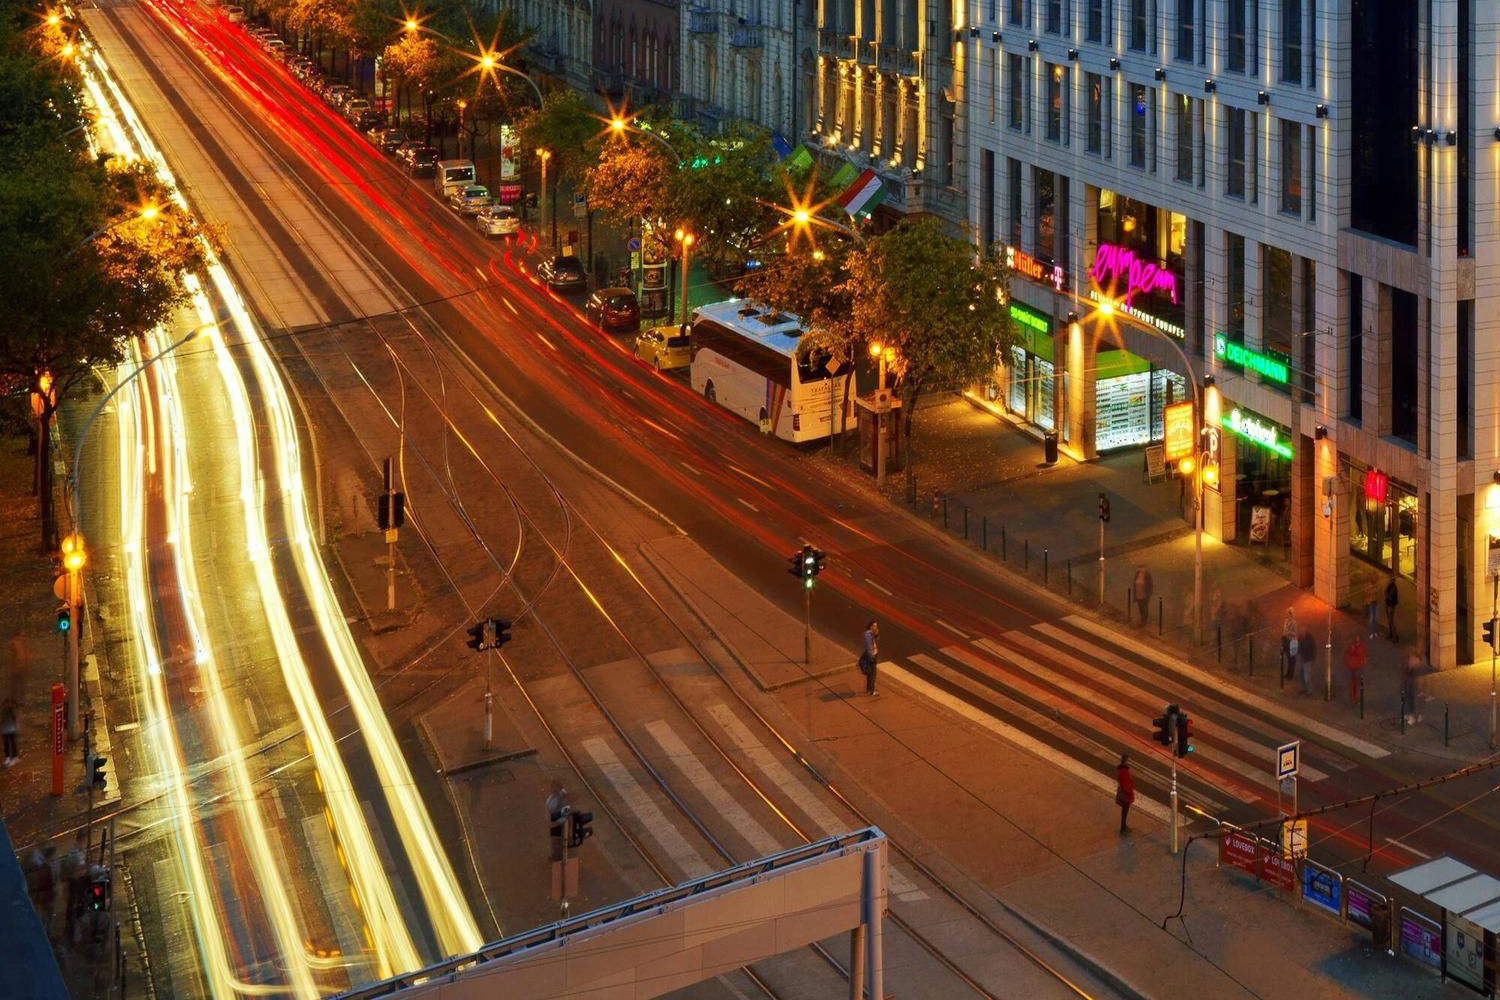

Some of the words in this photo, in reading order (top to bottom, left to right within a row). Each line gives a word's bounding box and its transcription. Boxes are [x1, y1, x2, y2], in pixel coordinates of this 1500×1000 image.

[1014, 250, 1043, 279] Müller
[1155, 318, 1184, 338] BUDAPES
[1227, 342, 1287, 383] DEICHMANN
[1232, 839, 1255, 855] LOVEBOX
